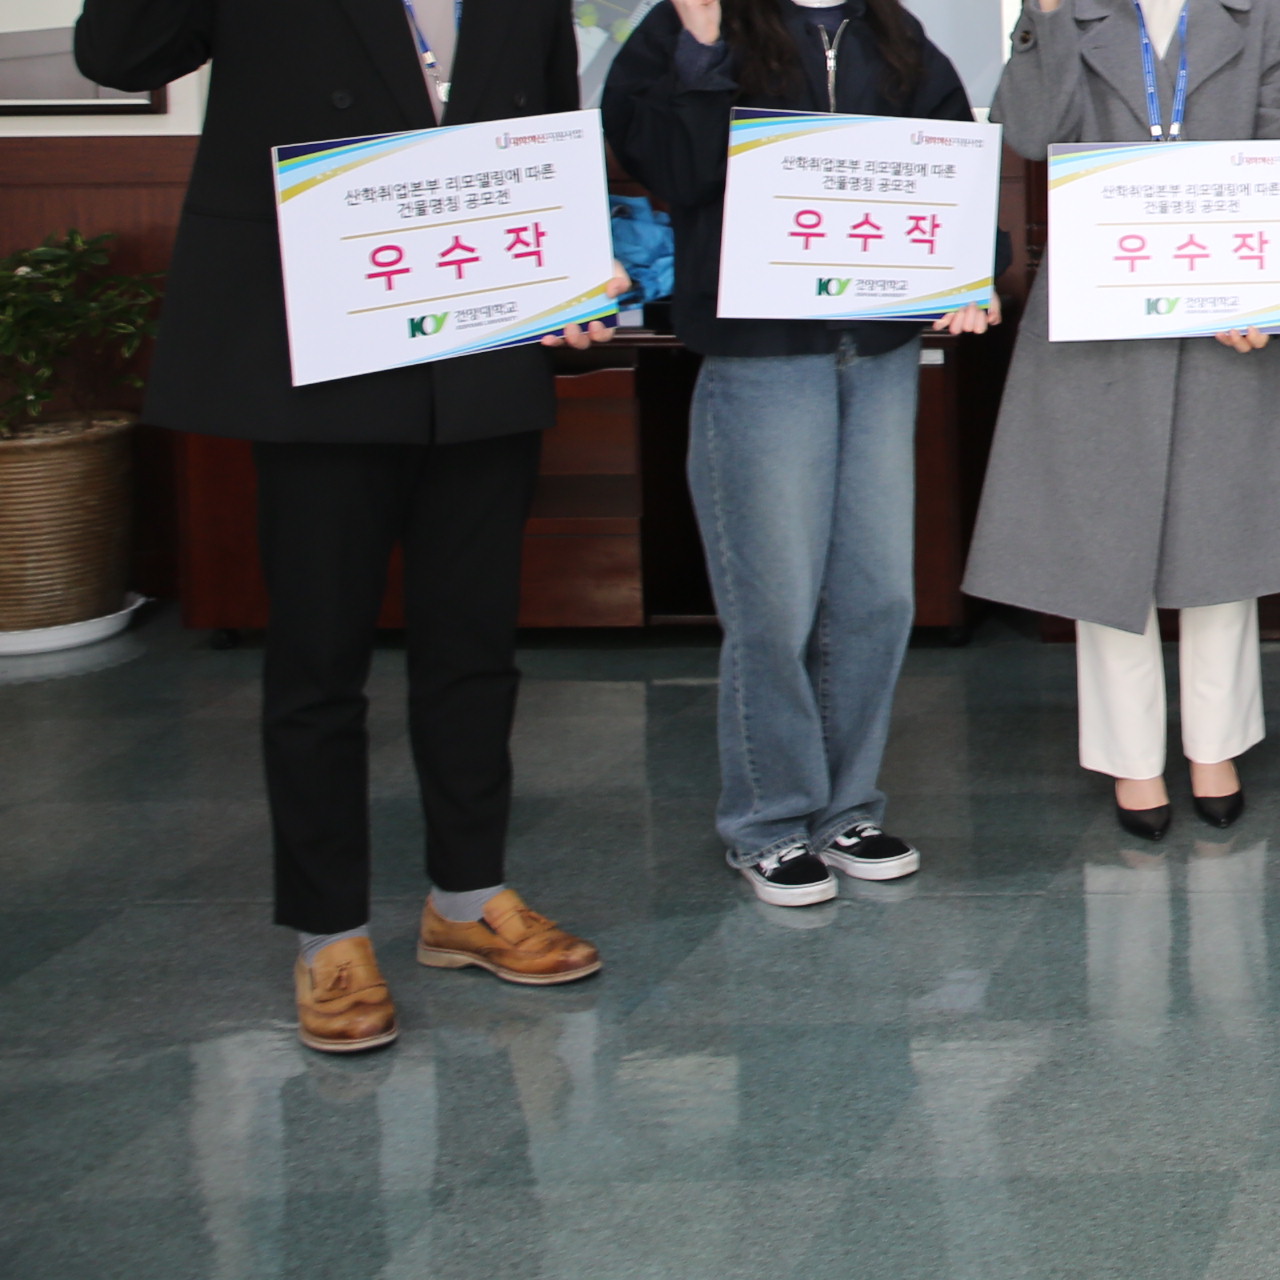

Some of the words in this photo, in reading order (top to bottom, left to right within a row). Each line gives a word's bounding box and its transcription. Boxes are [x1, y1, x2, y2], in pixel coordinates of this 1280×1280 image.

[781, 156, 860, 173] 산학취업본부
[930, 164, 957, 179] 따른
[344, 178, 441, 207] 산학취업본부
[445, 168, 521, 191] 리모델링에
[525, 163, 555, 180] 따른
[822, 175, 874, 192] 건물명칭
[877, 179, 916, 193] 공모전
[1101, 184, 1181, 199] 산학취업본부
[1254, 182, 1280, 196] 따른
[397, 195, 460, 219] 건물명칭
[464, 189, 512, 209] 공모전
[1144, 200, 1197, 214] 건물명칭
[1200, 199, 1240, 213] 공모전
